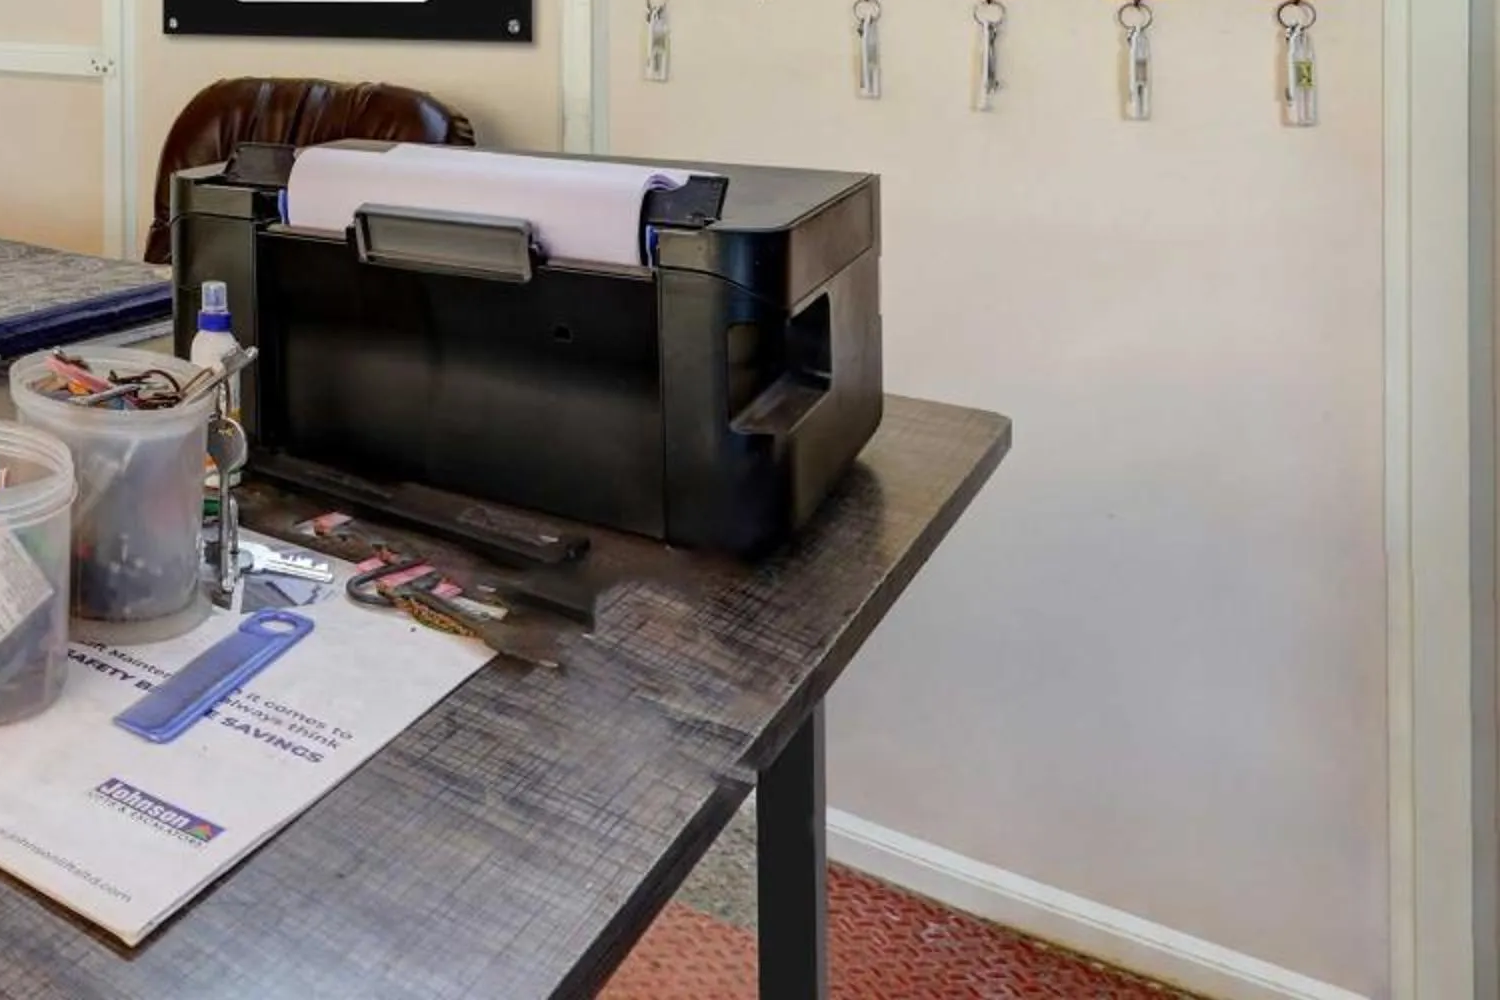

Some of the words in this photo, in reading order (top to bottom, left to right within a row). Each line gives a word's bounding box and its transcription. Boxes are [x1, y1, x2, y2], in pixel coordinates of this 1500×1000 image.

[220, 717, 325, 763] SAVINGS
[264, 700, 327, 730] comes
[332, 727, 353, 740] to
[288, 722, 341, 750] think
[100, 781, 191, 829] Johnson
